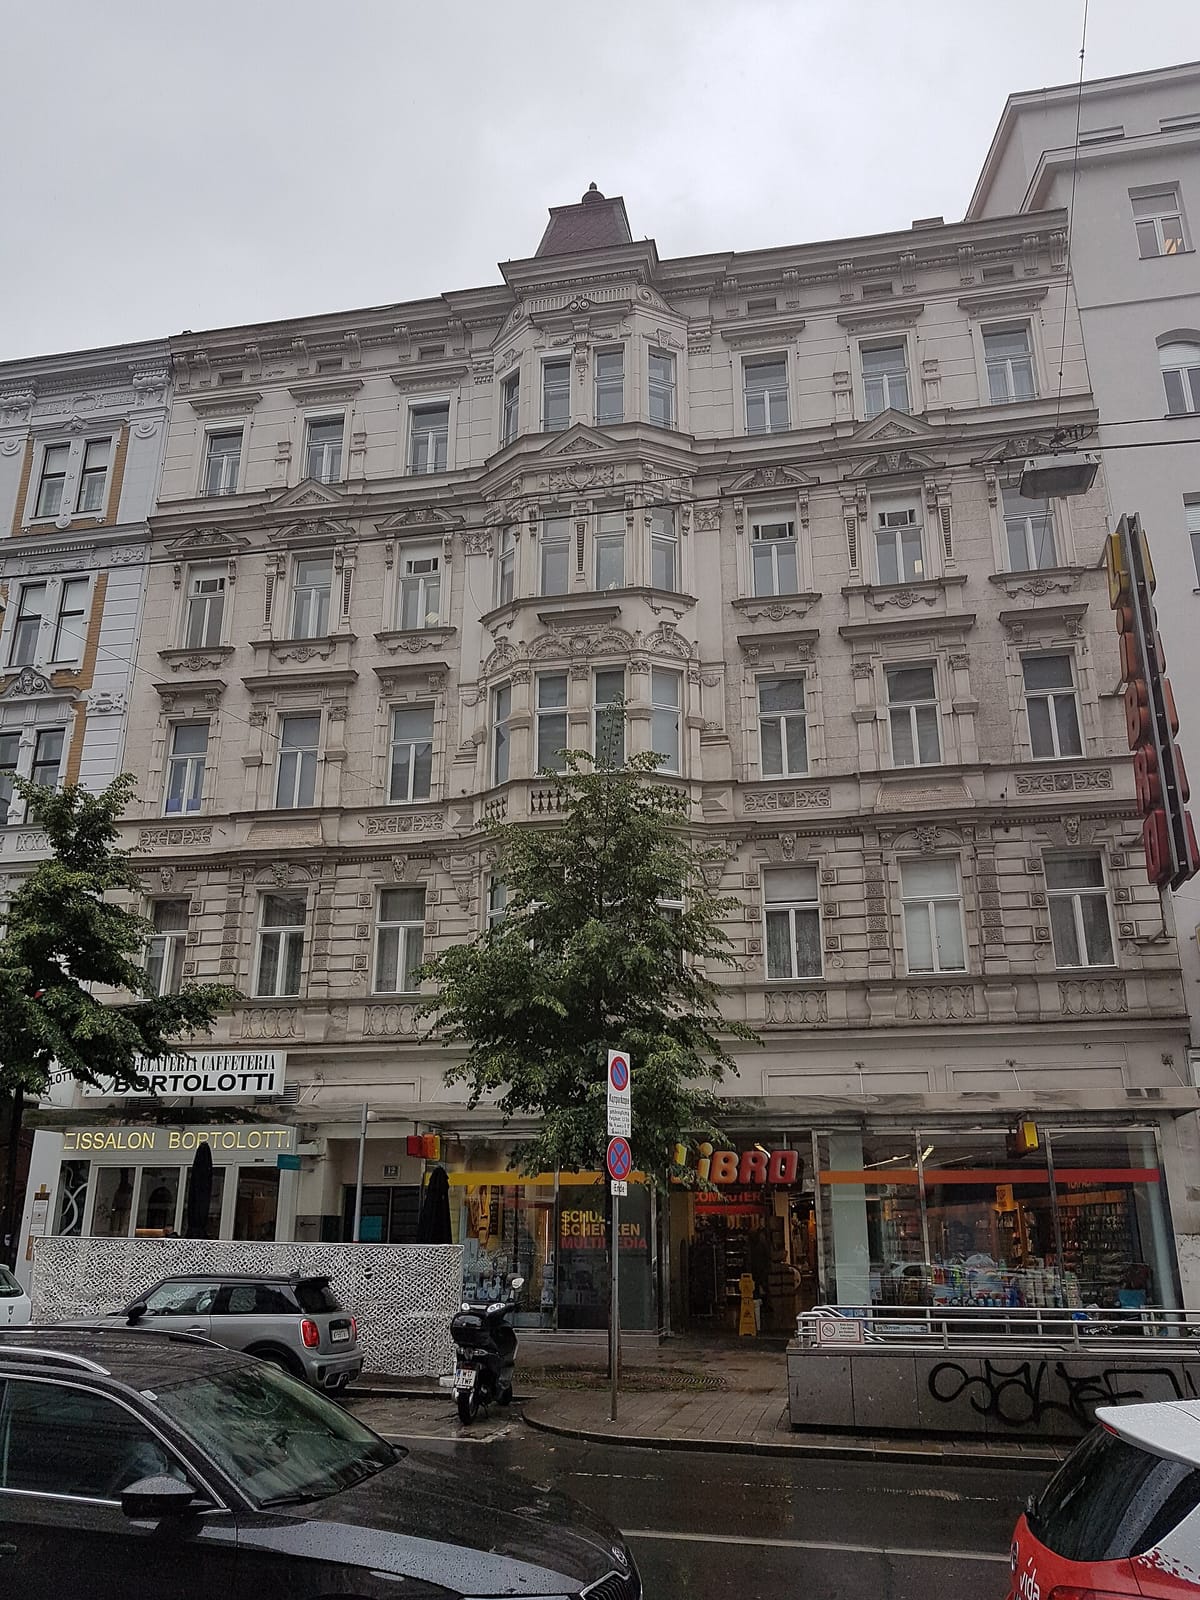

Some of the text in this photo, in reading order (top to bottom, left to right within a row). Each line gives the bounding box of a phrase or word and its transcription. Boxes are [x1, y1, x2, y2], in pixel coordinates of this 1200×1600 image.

[201, 1054, 276, 1071] CAFFETERIA
[113, 1073, 275, 1093] BORTOLOTTI
[168, 1131, 290, 1149] BORTOLOTTI
[695, 1191, 761, 1202] COMUTER
[561, 1223, 640, 1236] SCHENEN
[561, 1238, 648, 1249] MULTIEDIA
